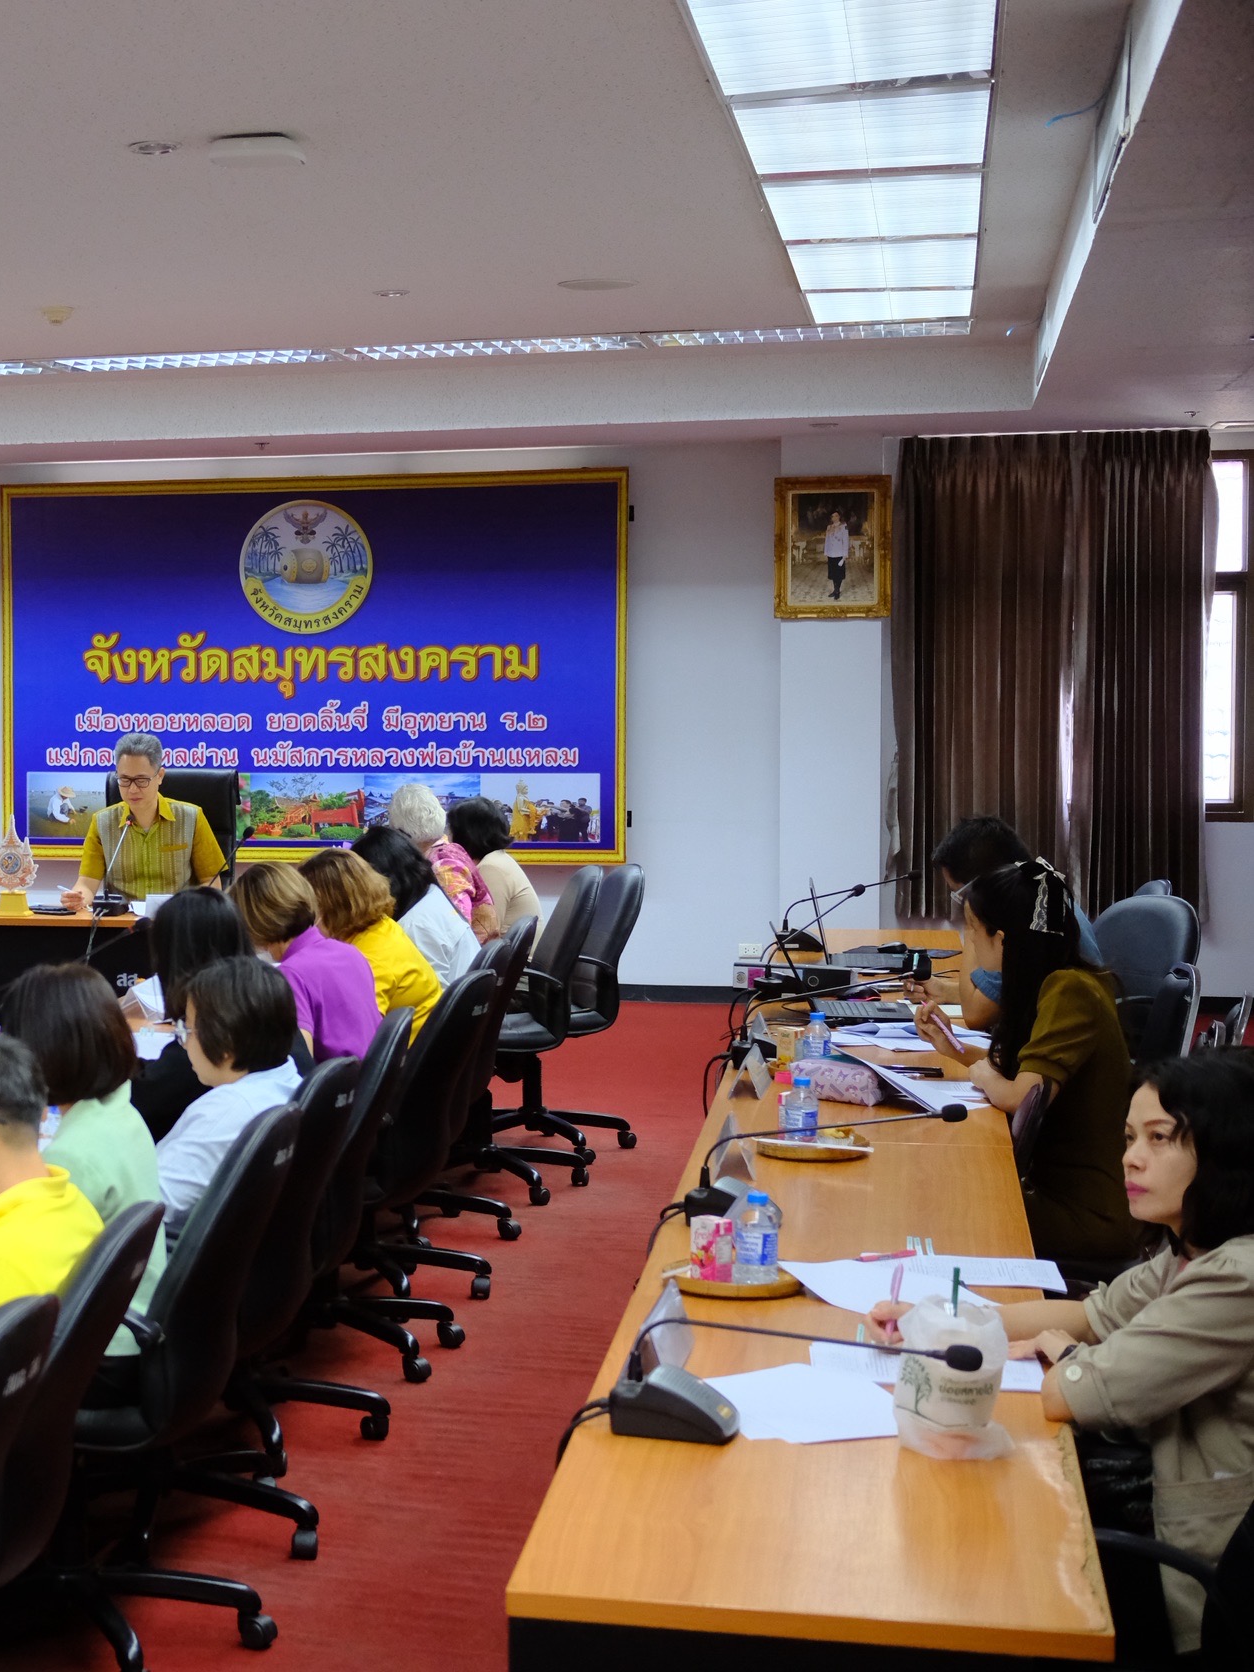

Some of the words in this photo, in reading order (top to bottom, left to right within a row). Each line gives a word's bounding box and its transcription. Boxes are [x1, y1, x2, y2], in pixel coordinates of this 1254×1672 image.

[251, 585, 364, 632] จังหวัดสมุทรสงคราม
[83, 631, 540, 699] จังหวัดสมุทรสงคราม
[75, 706, 252, 732] เมืองหอยหลอด
[266, 700, 369, 732] ยอดลิ้นจี่
[382, 705, 487, 739] มีอุทยาน
[500, 710, 548, 732] ร.๒
[46, 742, 239, 768] แม่กลหลผ่าน
[251, 740, 579, 768] นมัสการหลวงพ่อบ้านแหลม
